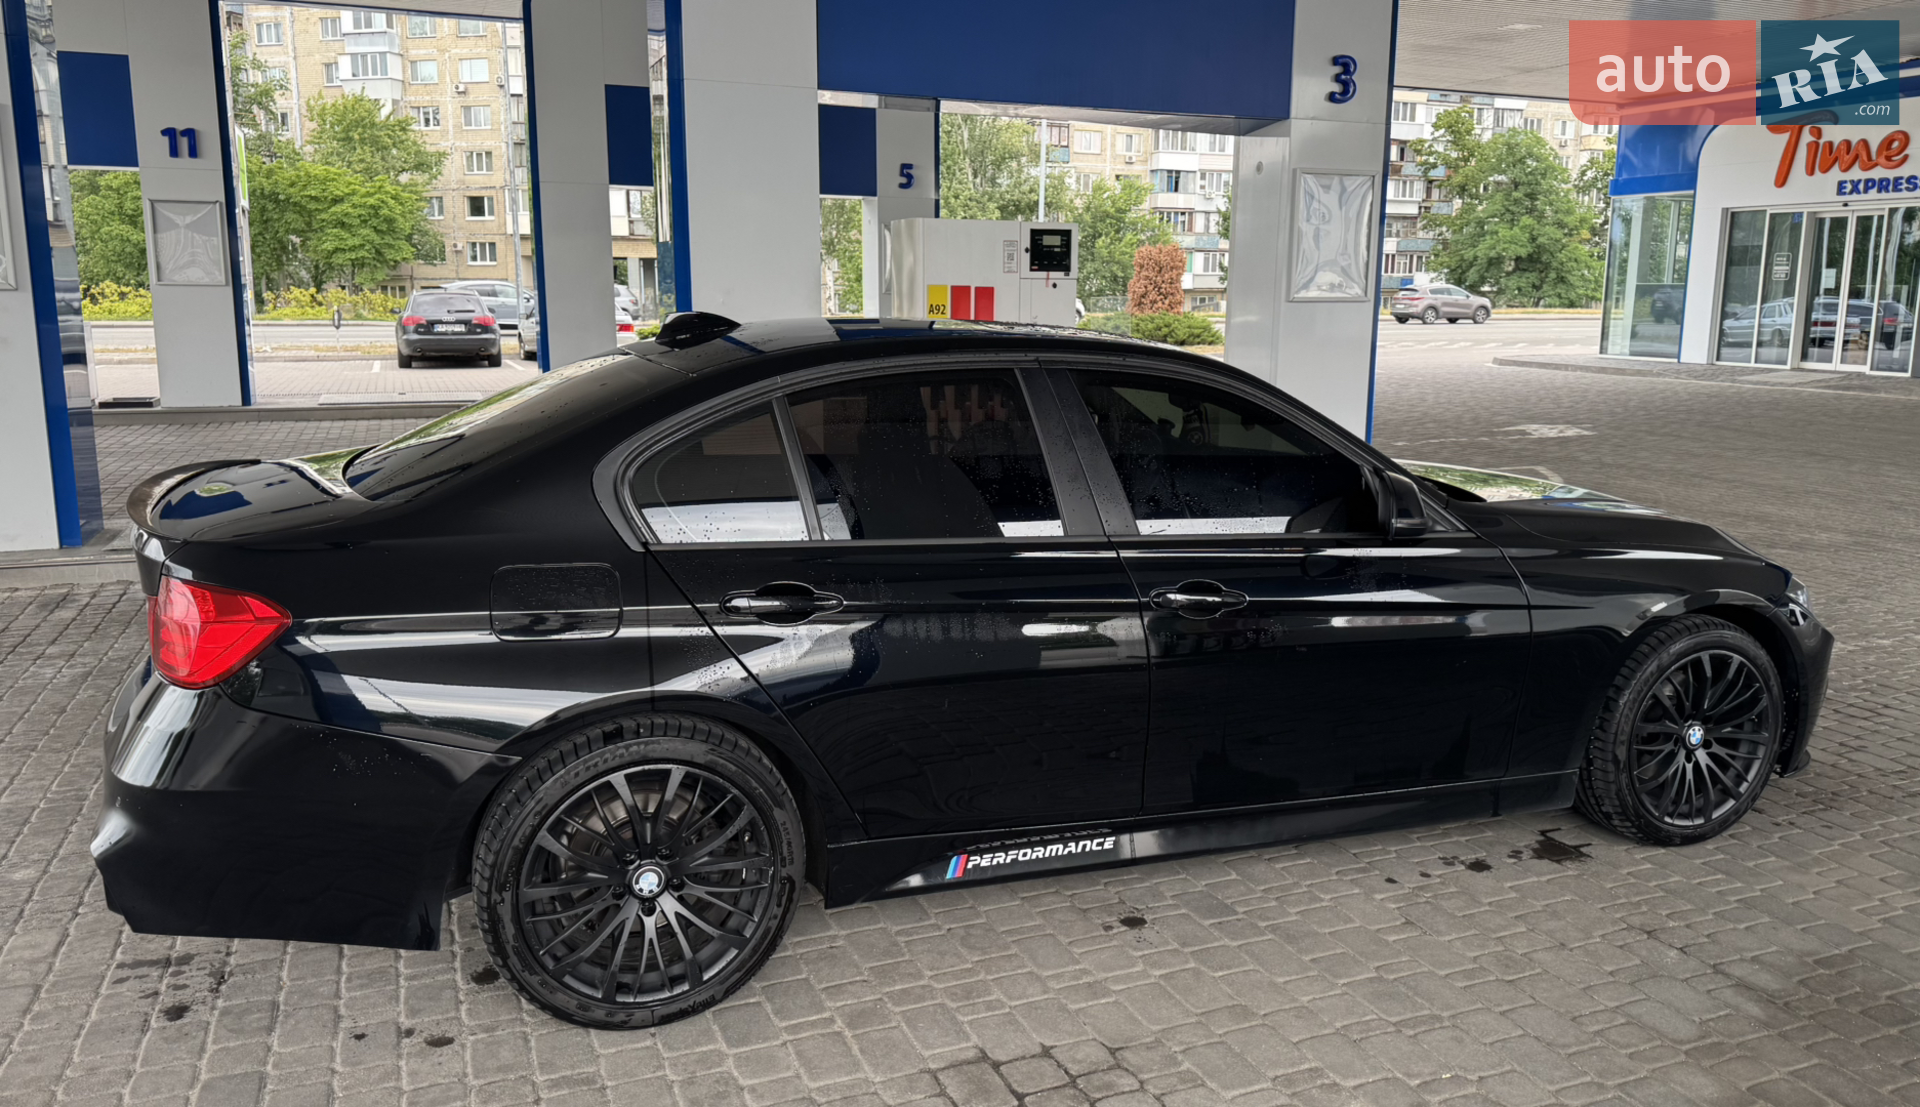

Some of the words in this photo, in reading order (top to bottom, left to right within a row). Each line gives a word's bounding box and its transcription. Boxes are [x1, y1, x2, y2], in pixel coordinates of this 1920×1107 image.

[1328, 54, 1358, 104] 3
[160, 127, 198, 158] 11
[1766, 110, 1911, 188] Time
[898, 163, 914, 189] 5
[1836, 174, 1920, 196] EXPRES
[928, 304, 946, 315] A92
[967, 836, 1116, 869] PERFORMANCE
